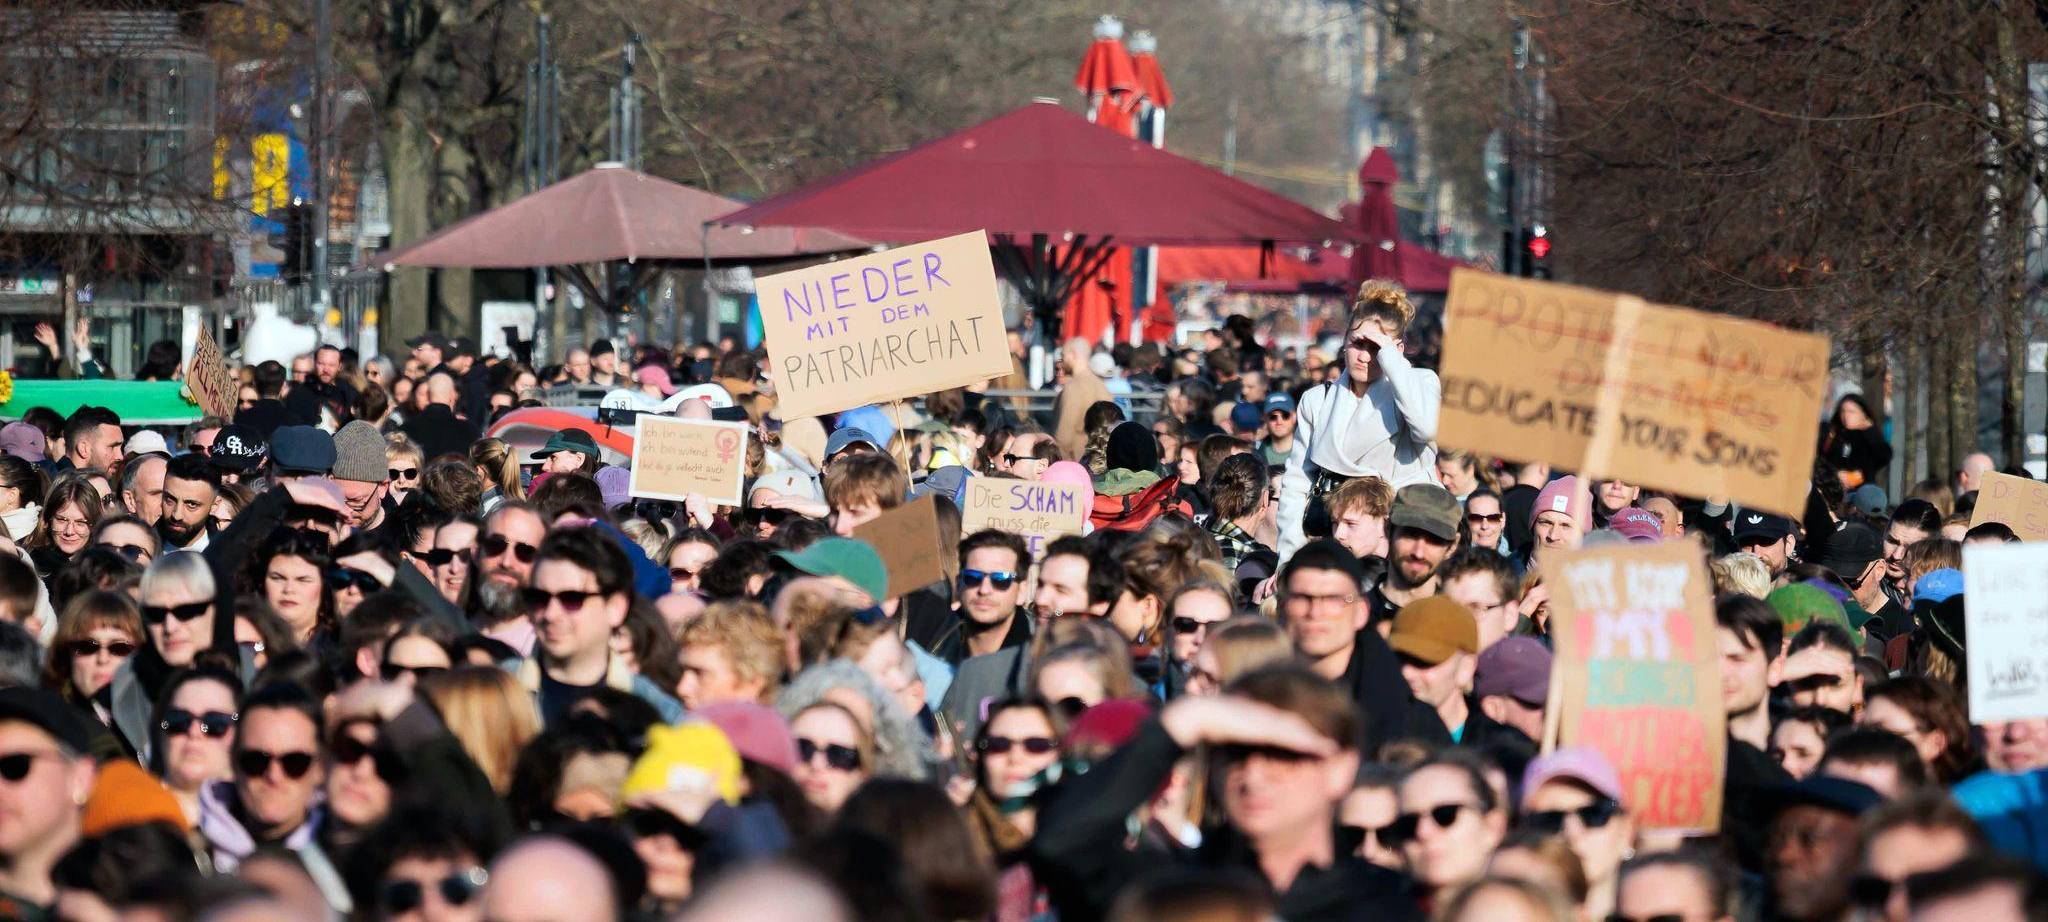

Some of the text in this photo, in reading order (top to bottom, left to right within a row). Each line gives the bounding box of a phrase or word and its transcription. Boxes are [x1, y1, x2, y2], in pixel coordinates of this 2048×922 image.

[783, 252, 951, 322] NIEDER
[807, 302, 930, 341] MIT DEM
[783, 316, 984, 392] PATRIARCHAT
[1441, 373, 1782, 477] EDUCATE YOUR SONS
[973, 485, 1074, 515] Die SCHAM
[986, 515, 1051, 533] muss die
